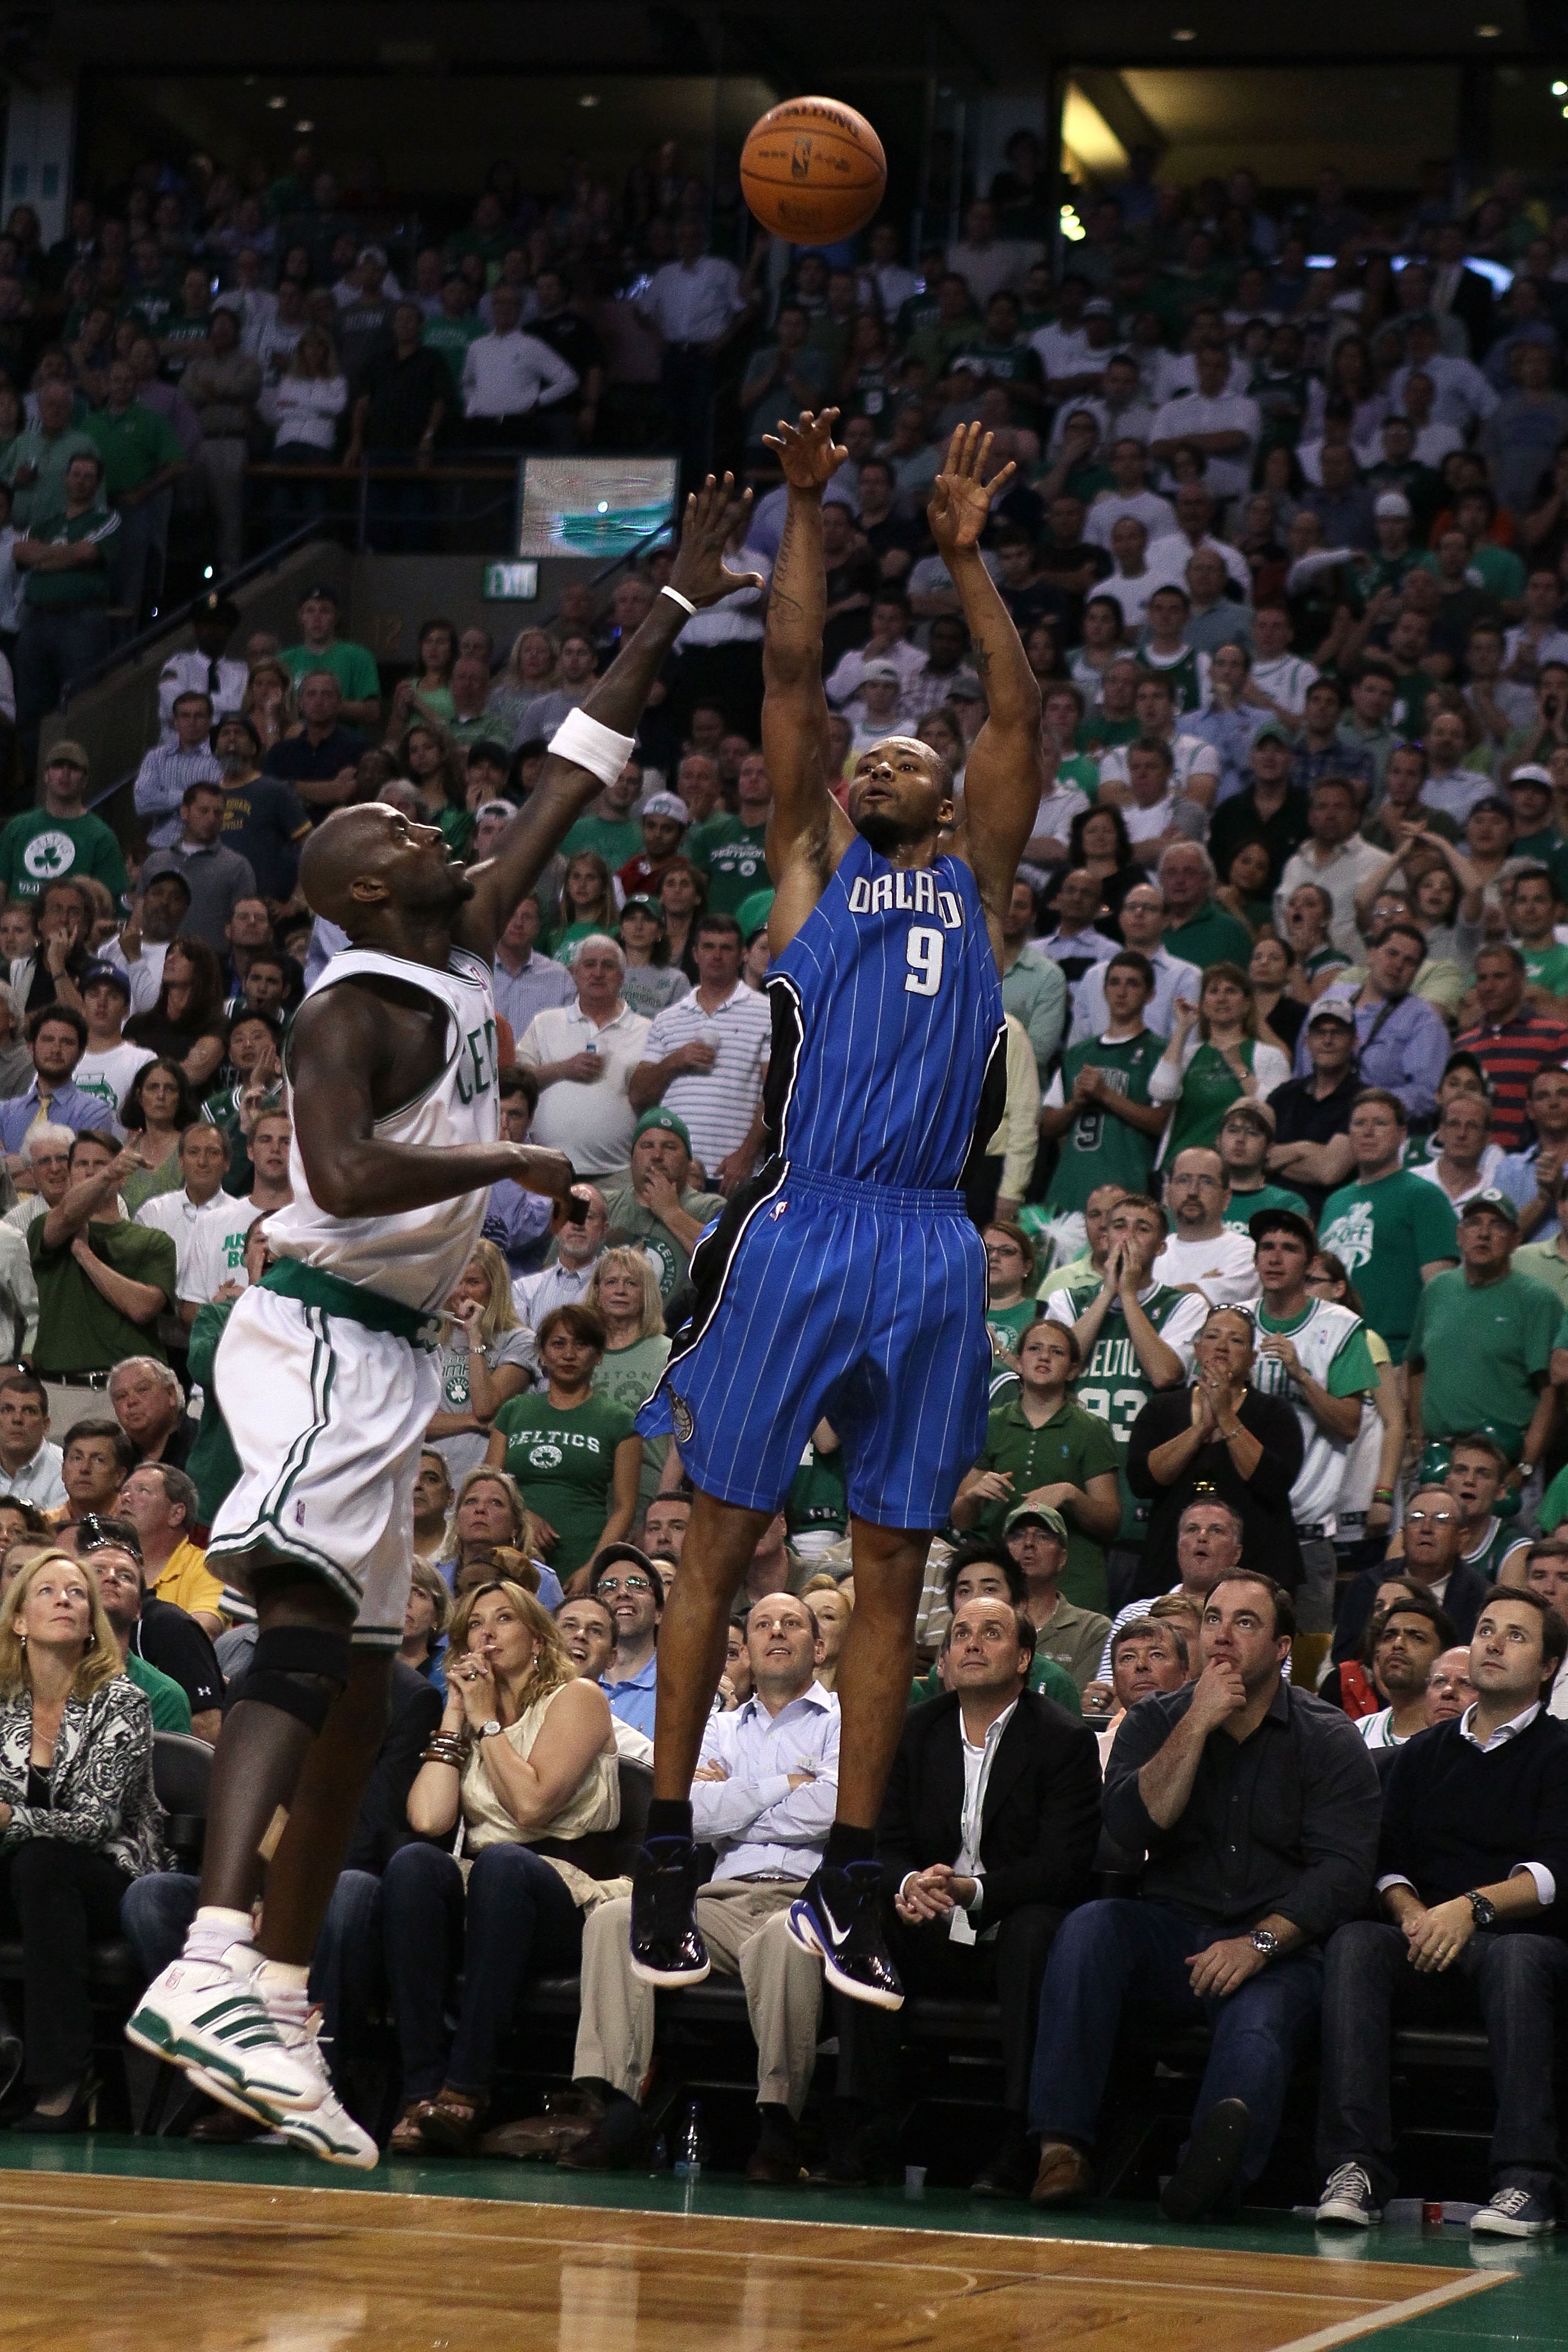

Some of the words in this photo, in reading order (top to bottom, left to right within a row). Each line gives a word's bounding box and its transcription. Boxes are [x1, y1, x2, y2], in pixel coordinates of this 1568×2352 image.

[905, 926, 945, 997] 9
[656, 1242, 674, 1294] CELTICS
[508, 1430, 601, 1455] CELTICS
